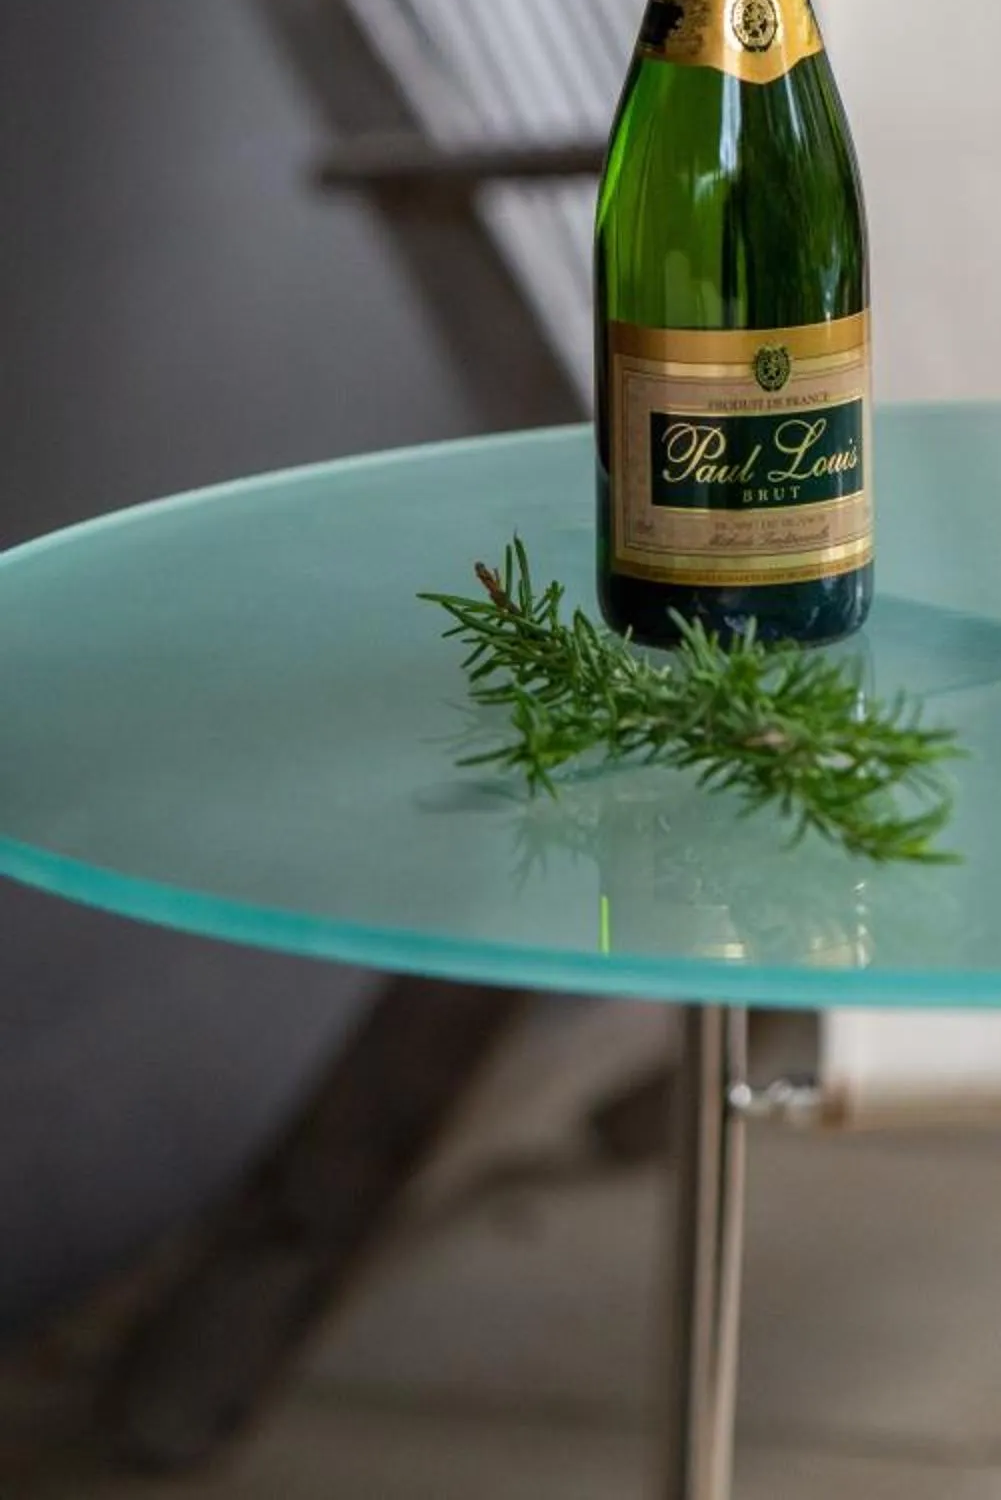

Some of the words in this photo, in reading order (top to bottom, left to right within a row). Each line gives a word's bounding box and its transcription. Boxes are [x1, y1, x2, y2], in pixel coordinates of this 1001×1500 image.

[785, 391, 829, 406] FRANCE
[661, 423, 762, 483] Paul
[767, 418, 858, 482] Louis
[742, 485, 801, 503] BRUT
